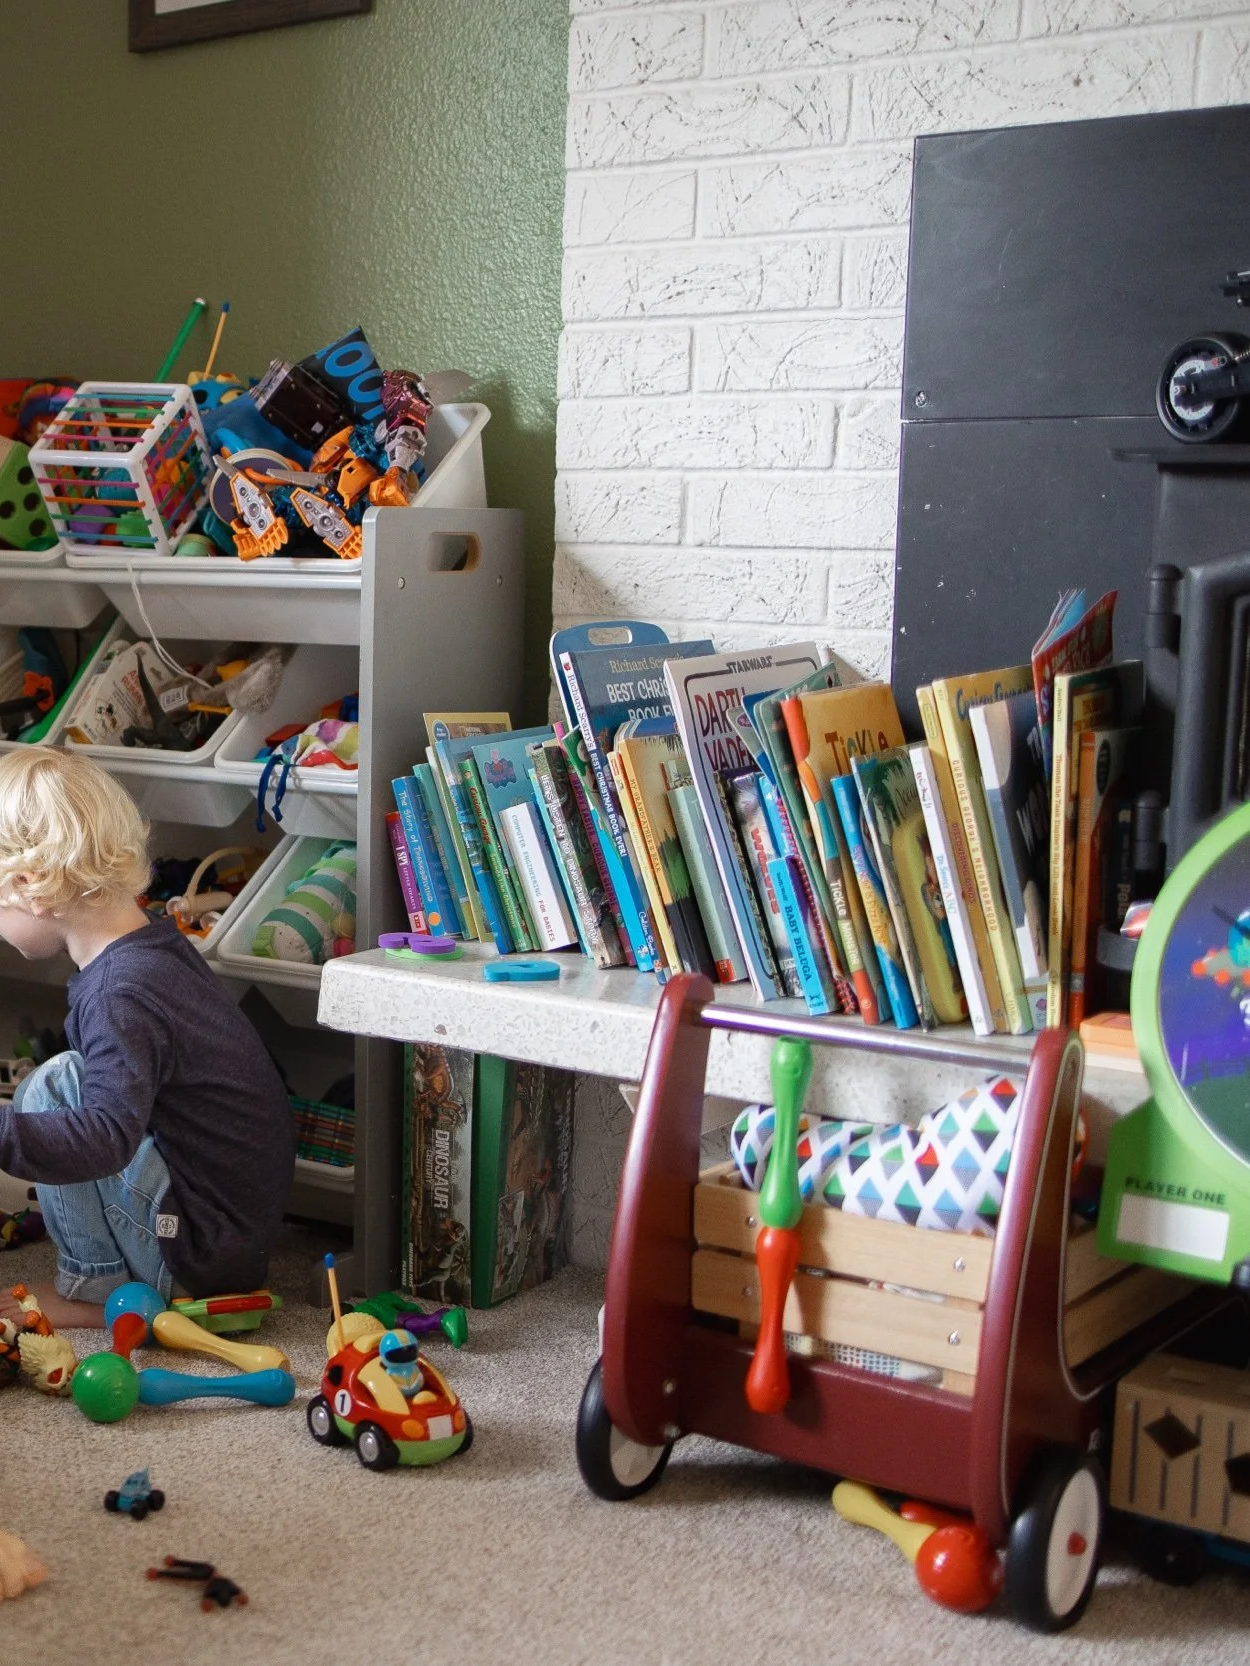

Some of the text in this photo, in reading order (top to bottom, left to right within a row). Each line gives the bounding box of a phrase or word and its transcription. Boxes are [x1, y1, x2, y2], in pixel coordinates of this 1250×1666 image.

[609, 658, 649, 673] Richard
[567, 674, 595, 748] Richard Scarry's
[607, 682, 635, 703] BEST
[703, 735, 754, 771] VADE
[398, 790, 408, 806] The
[469, 787, 491, 844] Curious George
[549, 801, 566, 837] LISTEN
[590, 752, 600, 770] BEST
[607, 813, 620, 834] BOOK
[615, 835, 627, 857] EVER!
[402, 808, 415, 832] Story
[409, 834, 418, 843] of
[630, 777, 638, 790] MY
[650, 852, 661, 873] BEAR
[396, 851, 408, 867] SPY
[560, 839, 571, 854] TO
[571, 778, 586, 805] HAPPY
[590, 841, 606, 874] CURIOUS
[602, 877, 616, 906] GEORGE
[952, 759, 967, 801] CURIOUS
[974, 857, 997, 931] NEIGHBORHOOD
[490, 852, 502, 877] Sounds
[502, 893, 516, 928] Christmas
[511, 814, 555, 942] COMPUTER ENGINEERING FOR BABIES
[565, 857, 587, 906] DINOSAUR
[749, 827, 781, 915] WOLVES
[581, 909, 599, 945] STORY
[783, 904, 813, 981] BABY BELUGA
[433, 1129, 450, 1209] DINOSAUR
[1126, 1176, 1226, 1205] PLAYER ONE
[340, 1394, 346, 1412] 1
